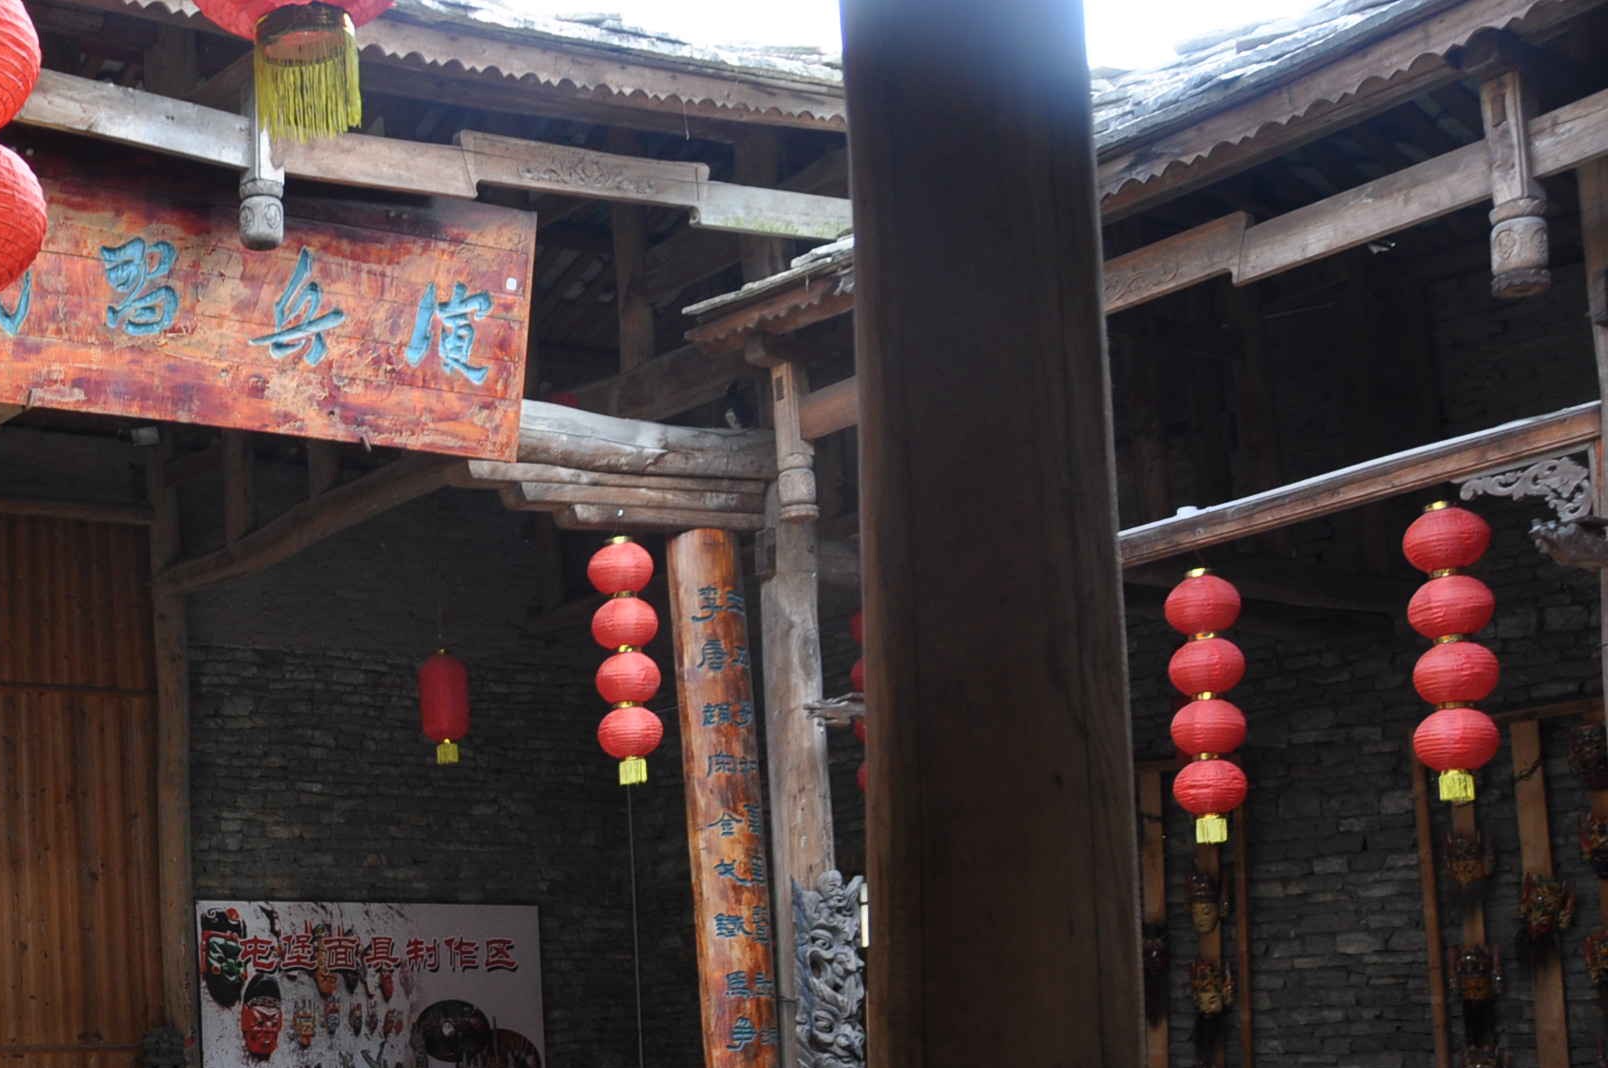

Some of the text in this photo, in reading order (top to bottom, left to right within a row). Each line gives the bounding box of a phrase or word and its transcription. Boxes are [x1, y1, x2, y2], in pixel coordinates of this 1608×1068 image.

[239, 933, 519, 973] 屯堡面具制作区
